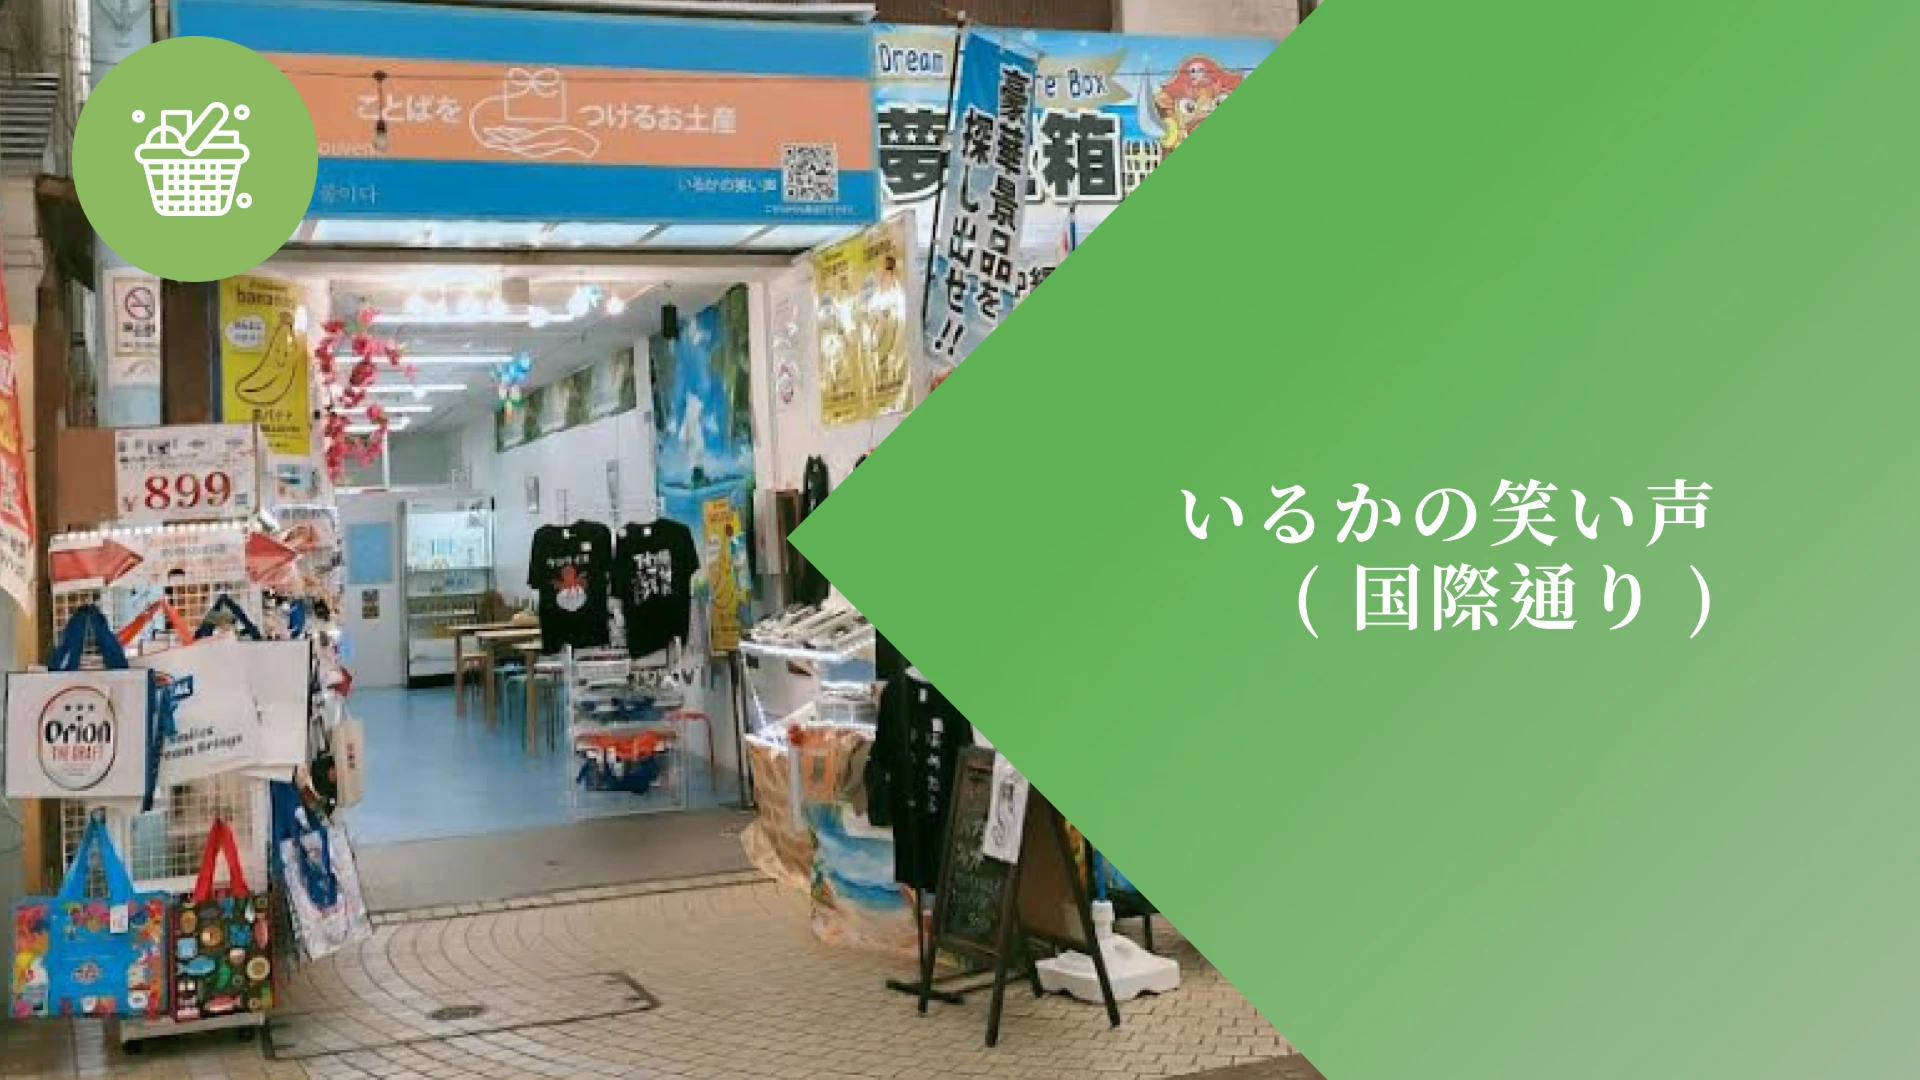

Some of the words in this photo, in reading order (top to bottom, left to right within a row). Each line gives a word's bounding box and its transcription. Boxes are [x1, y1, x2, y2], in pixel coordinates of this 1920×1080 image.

[355, 93, 463, 125] ことばを
[578, 101, 738, 134] つけるお土産
[44, 719, 112, 745] Orion
